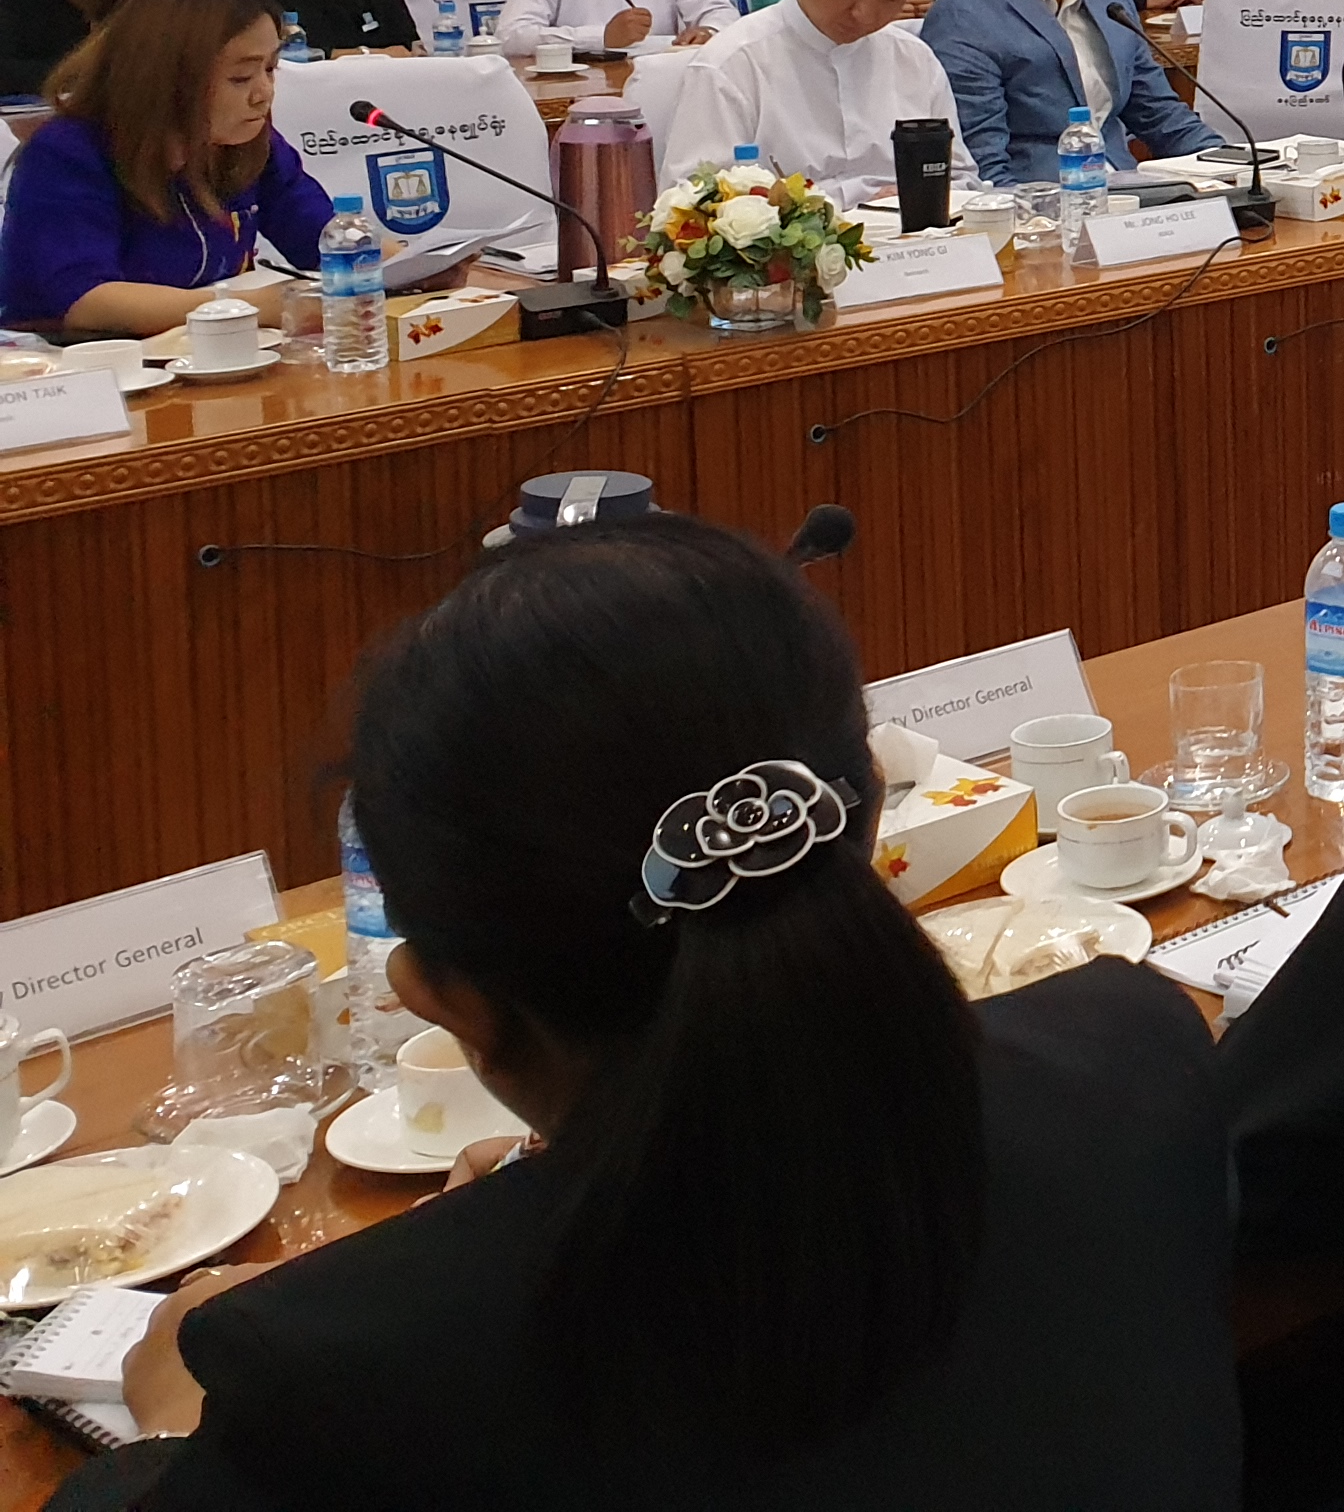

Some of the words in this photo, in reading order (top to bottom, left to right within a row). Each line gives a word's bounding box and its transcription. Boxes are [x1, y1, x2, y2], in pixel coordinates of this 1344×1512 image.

[911, 696, 971, 723] Director
[975, 675, 1034, 705] General
[12, 959, 107, 1000] Director
[114, 927, 204, 968] General
